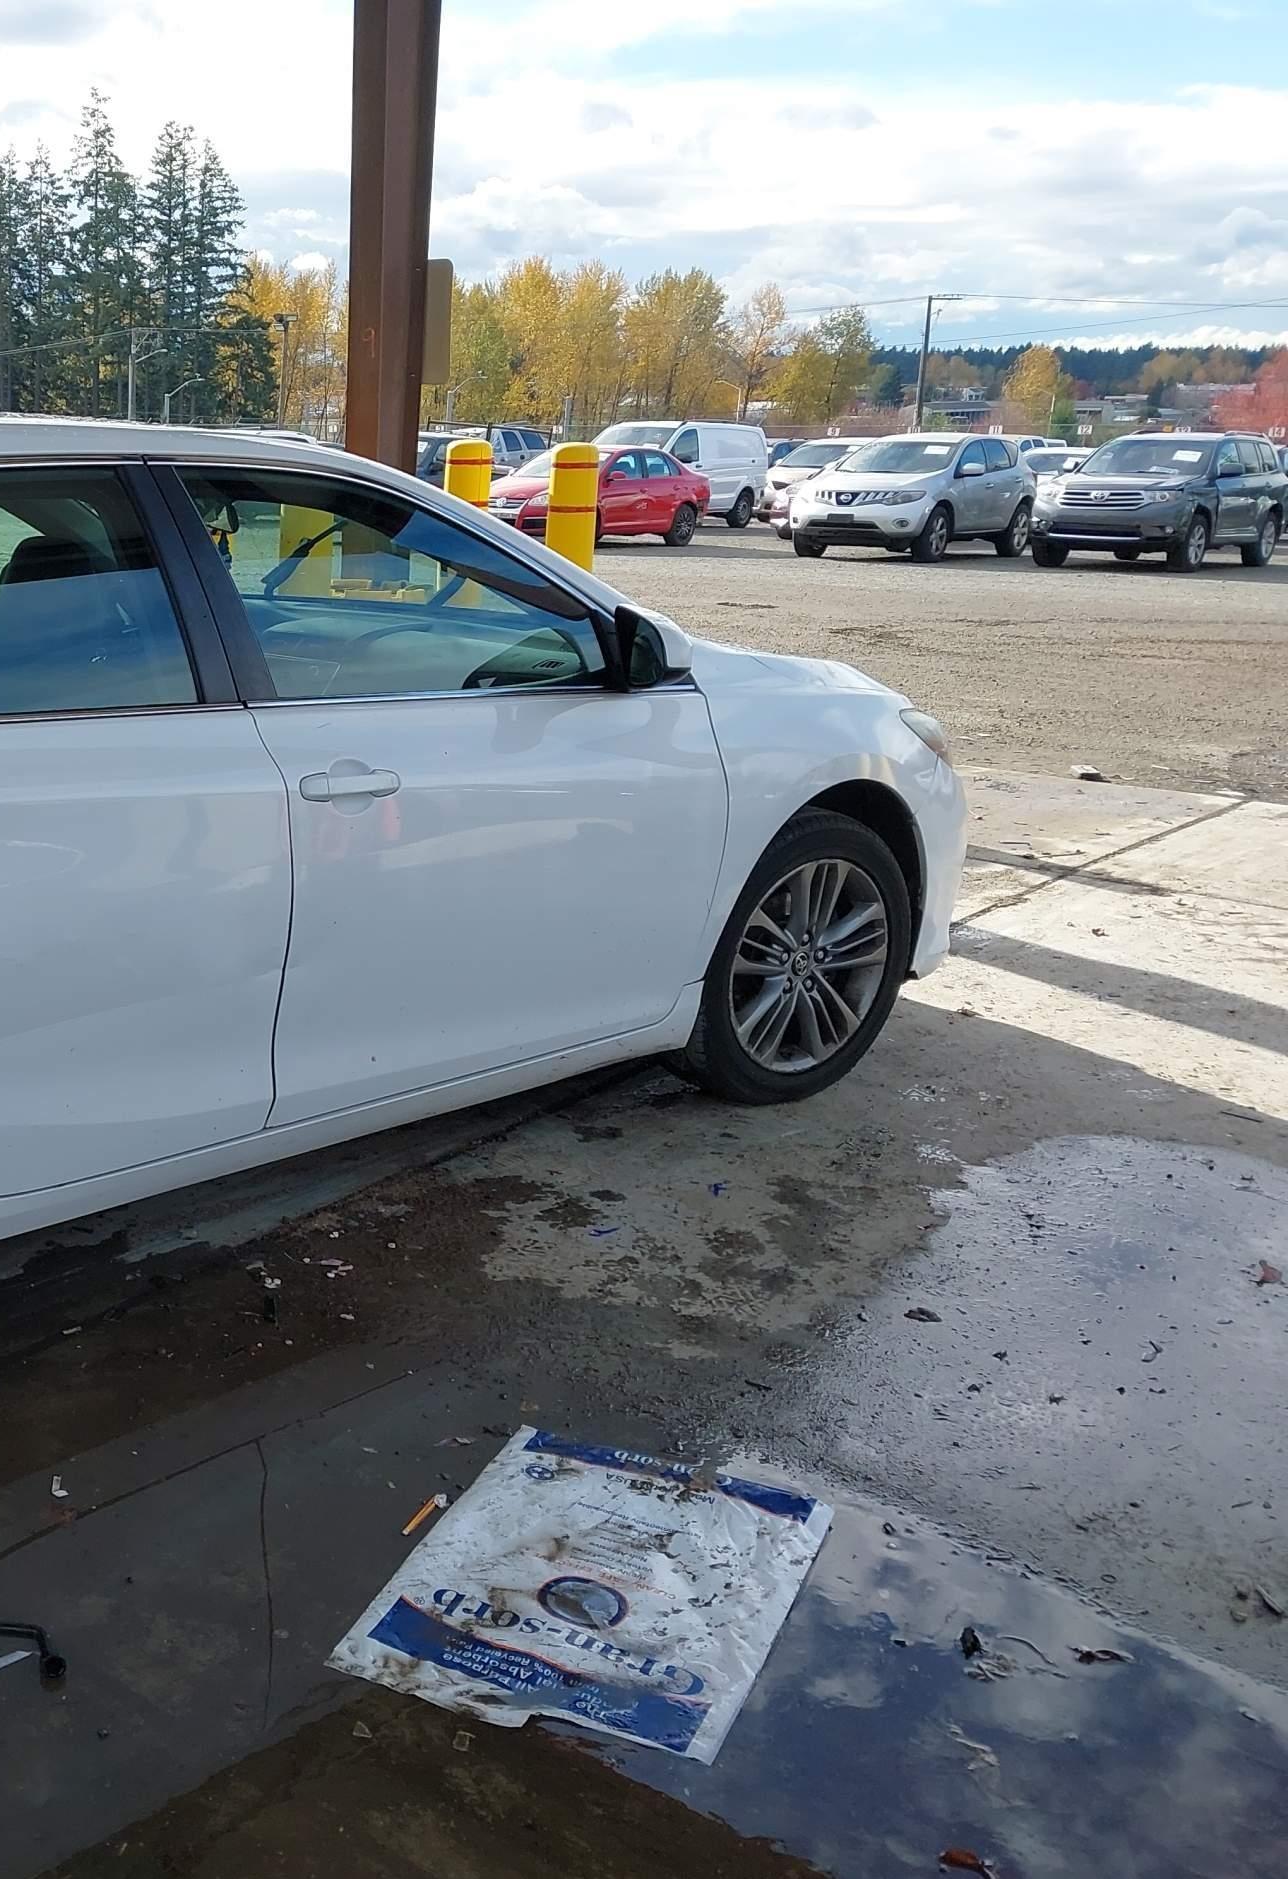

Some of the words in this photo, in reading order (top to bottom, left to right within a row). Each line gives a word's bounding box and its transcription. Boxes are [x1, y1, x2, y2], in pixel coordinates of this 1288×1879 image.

[606, 1472, 631, 1485] USA
[441, 1651, 511, 1687] Purpose
[531, 1662, 565, 1680] 100%
[513, 1679, 538, 1694] All
